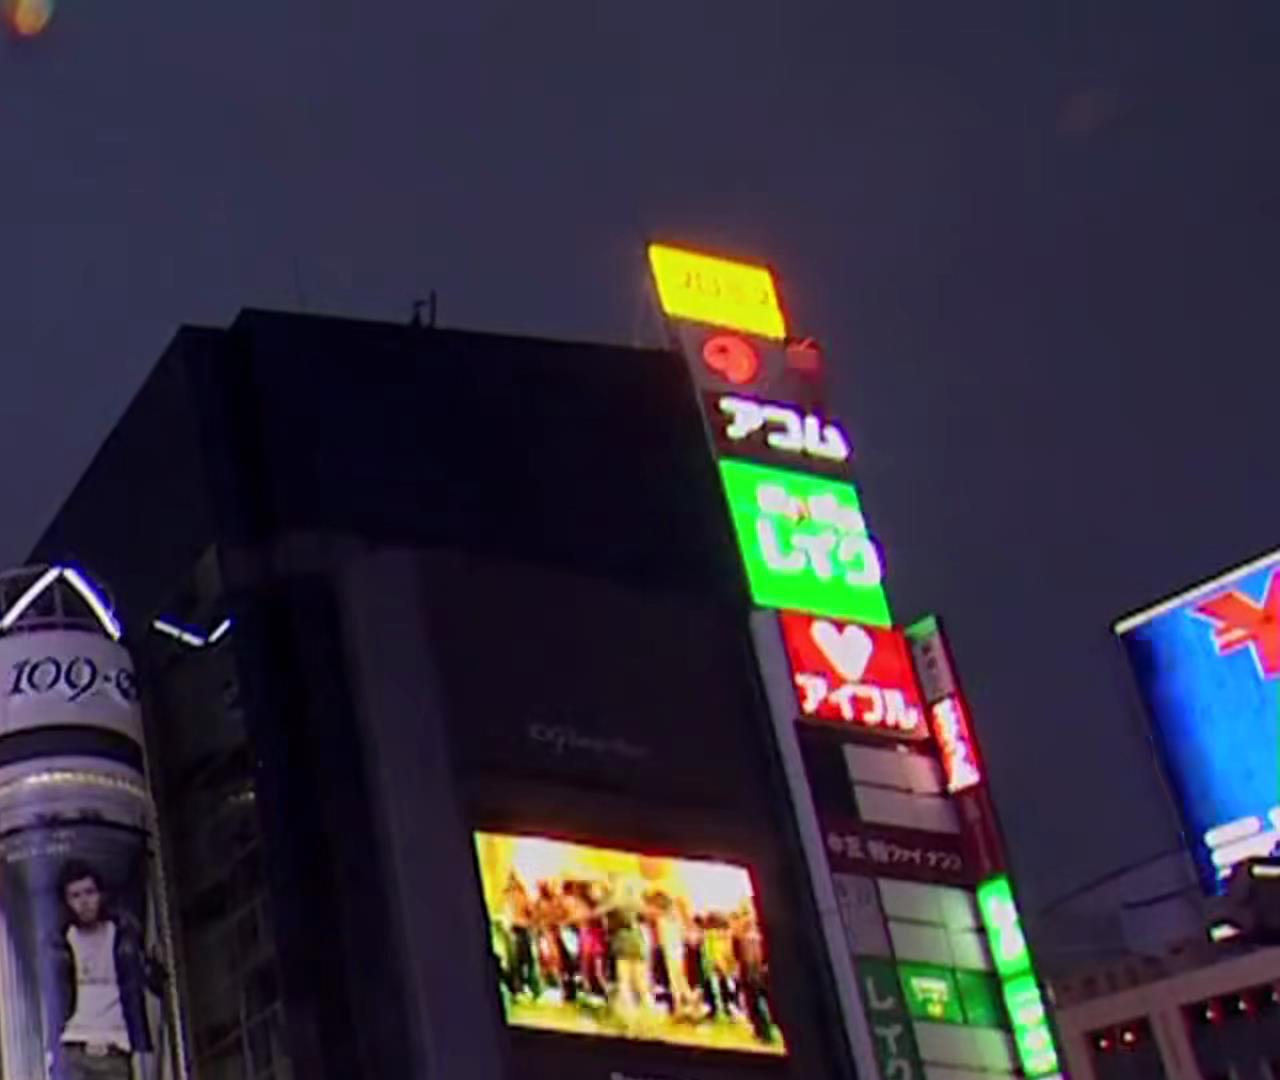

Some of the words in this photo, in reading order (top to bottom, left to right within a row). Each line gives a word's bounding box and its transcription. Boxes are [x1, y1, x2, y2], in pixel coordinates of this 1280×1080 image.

[718, 396, 851, 461] アコム
[794, 673, 919, 731] アイフル
